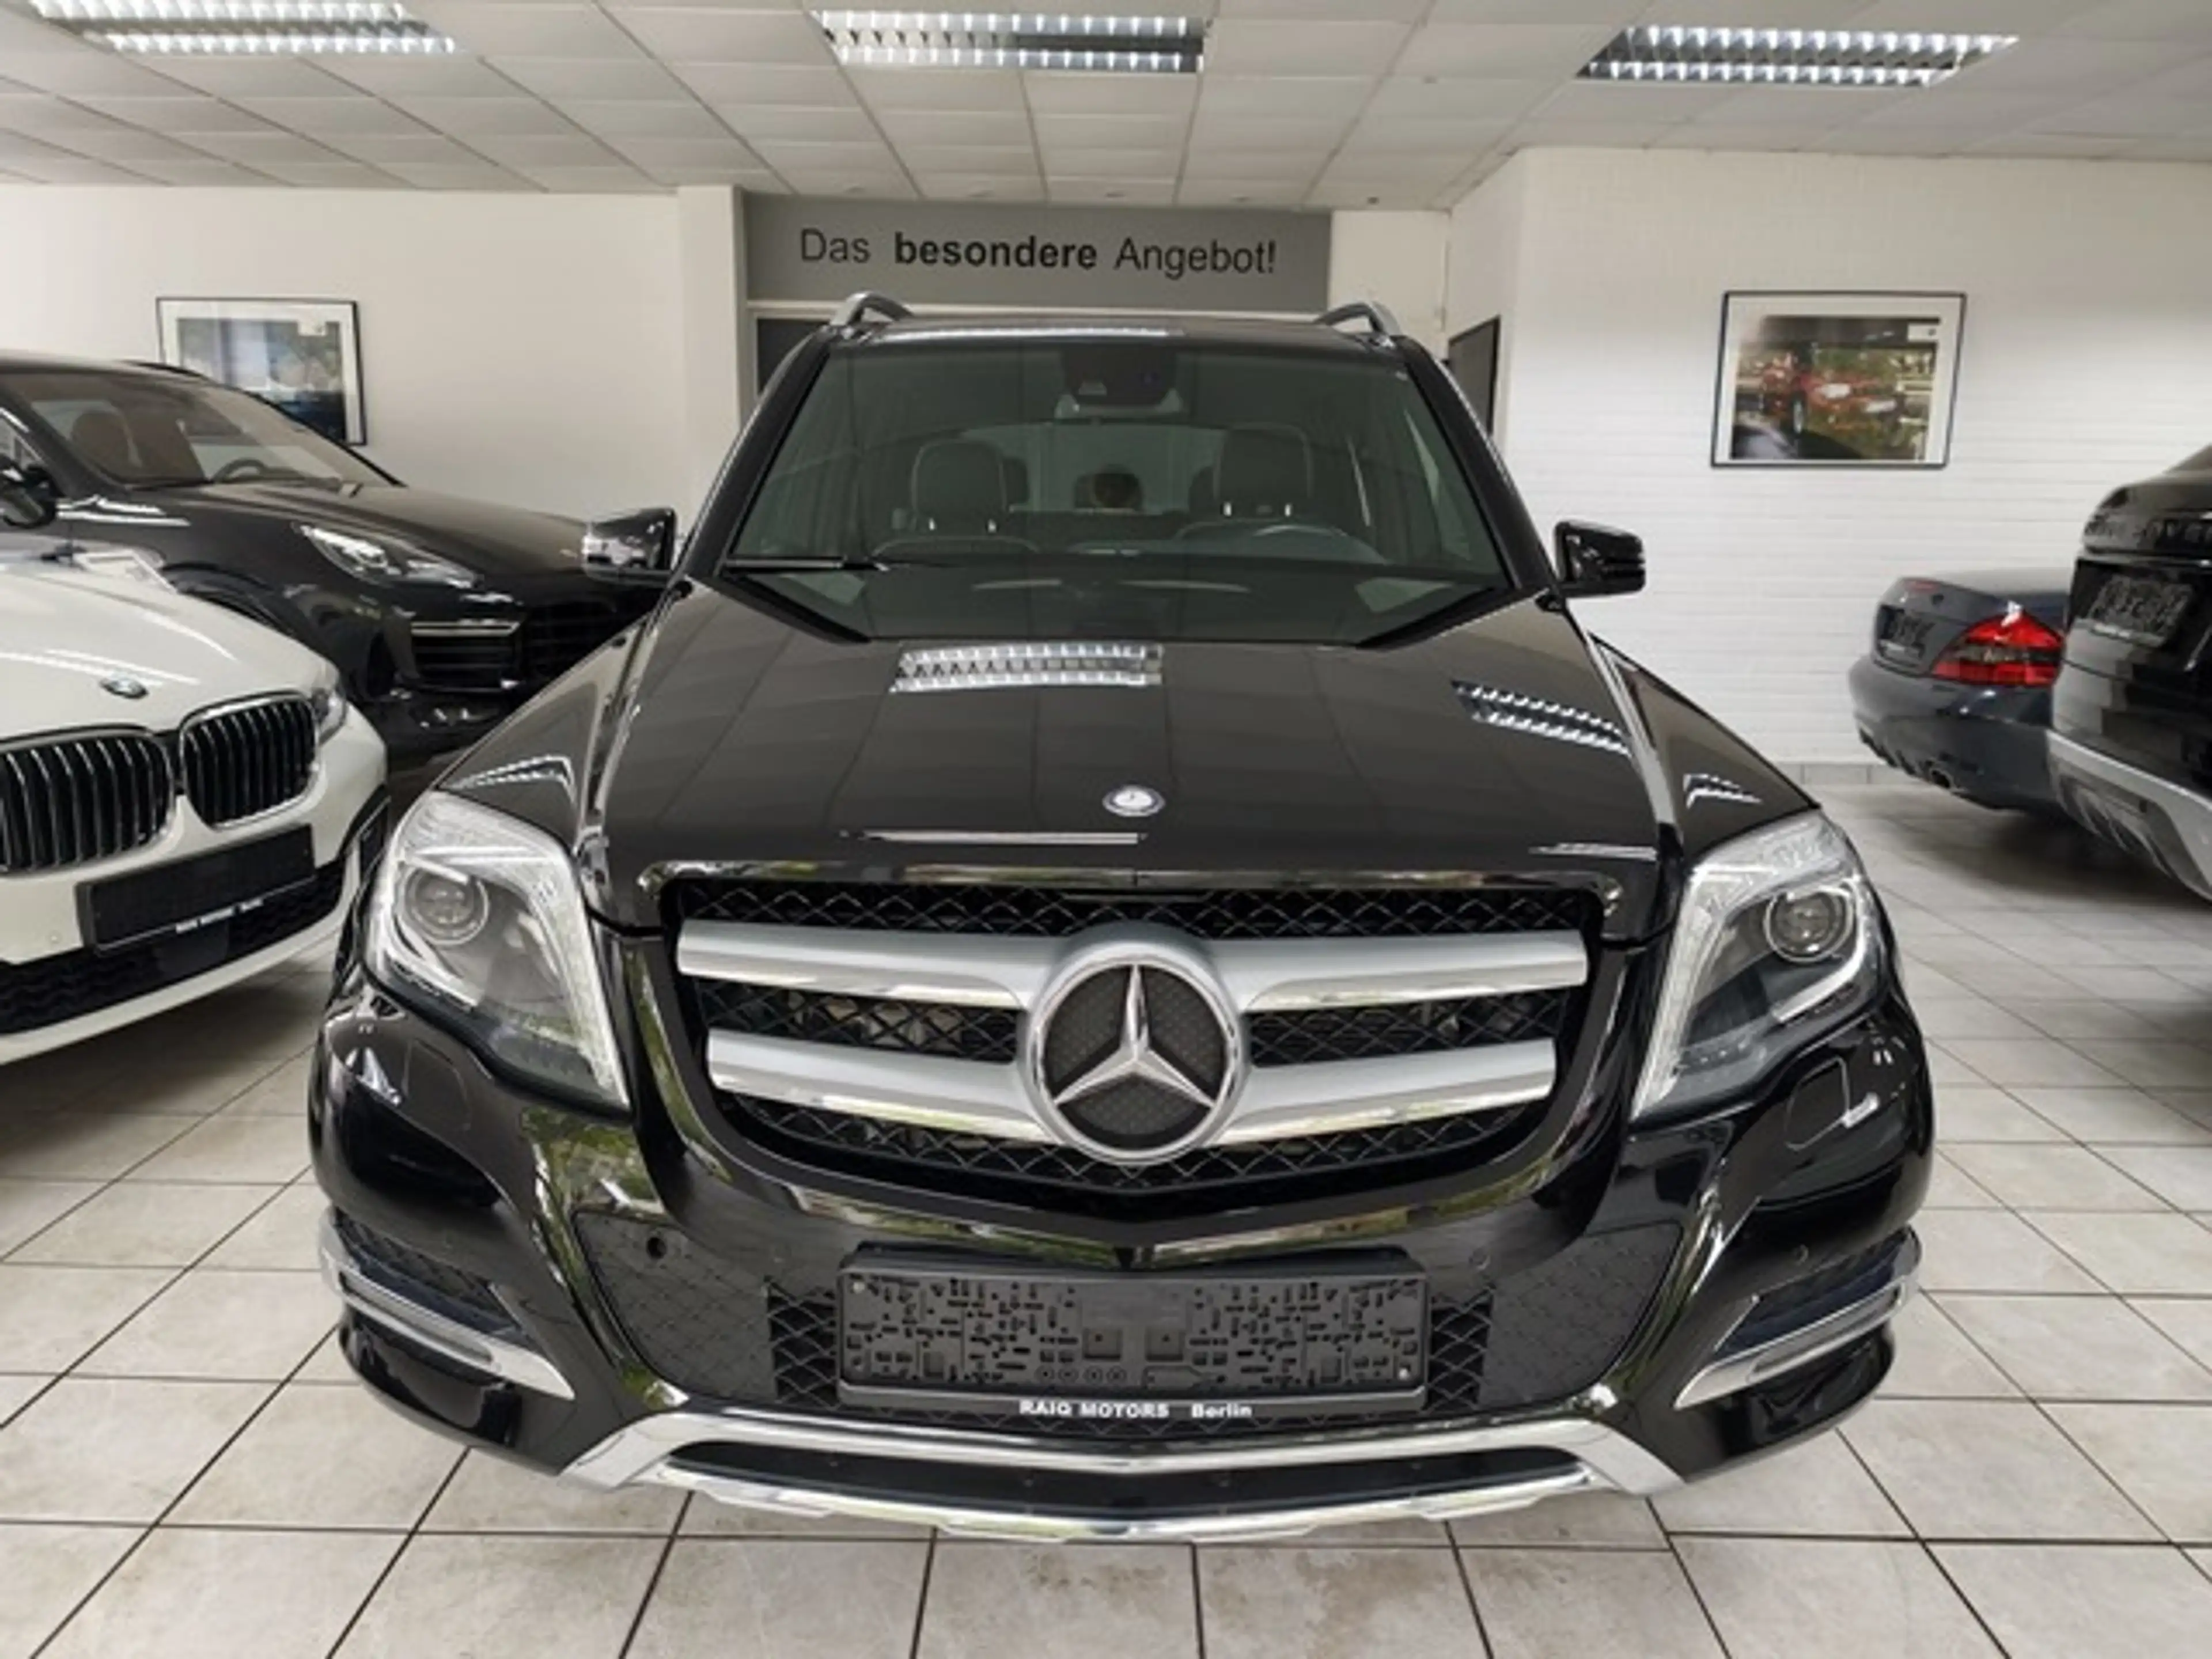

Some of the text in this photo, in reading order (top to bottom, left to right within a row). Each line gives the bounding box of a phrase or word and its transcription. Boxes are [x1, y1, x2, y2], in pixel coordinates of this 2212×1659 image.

[800, 228, 1275, 279] Das besondere Angebot!
[1080, 1402, 1169, 1418] MOTORS
[1191, 1403, 1252, 1418] Berlin
